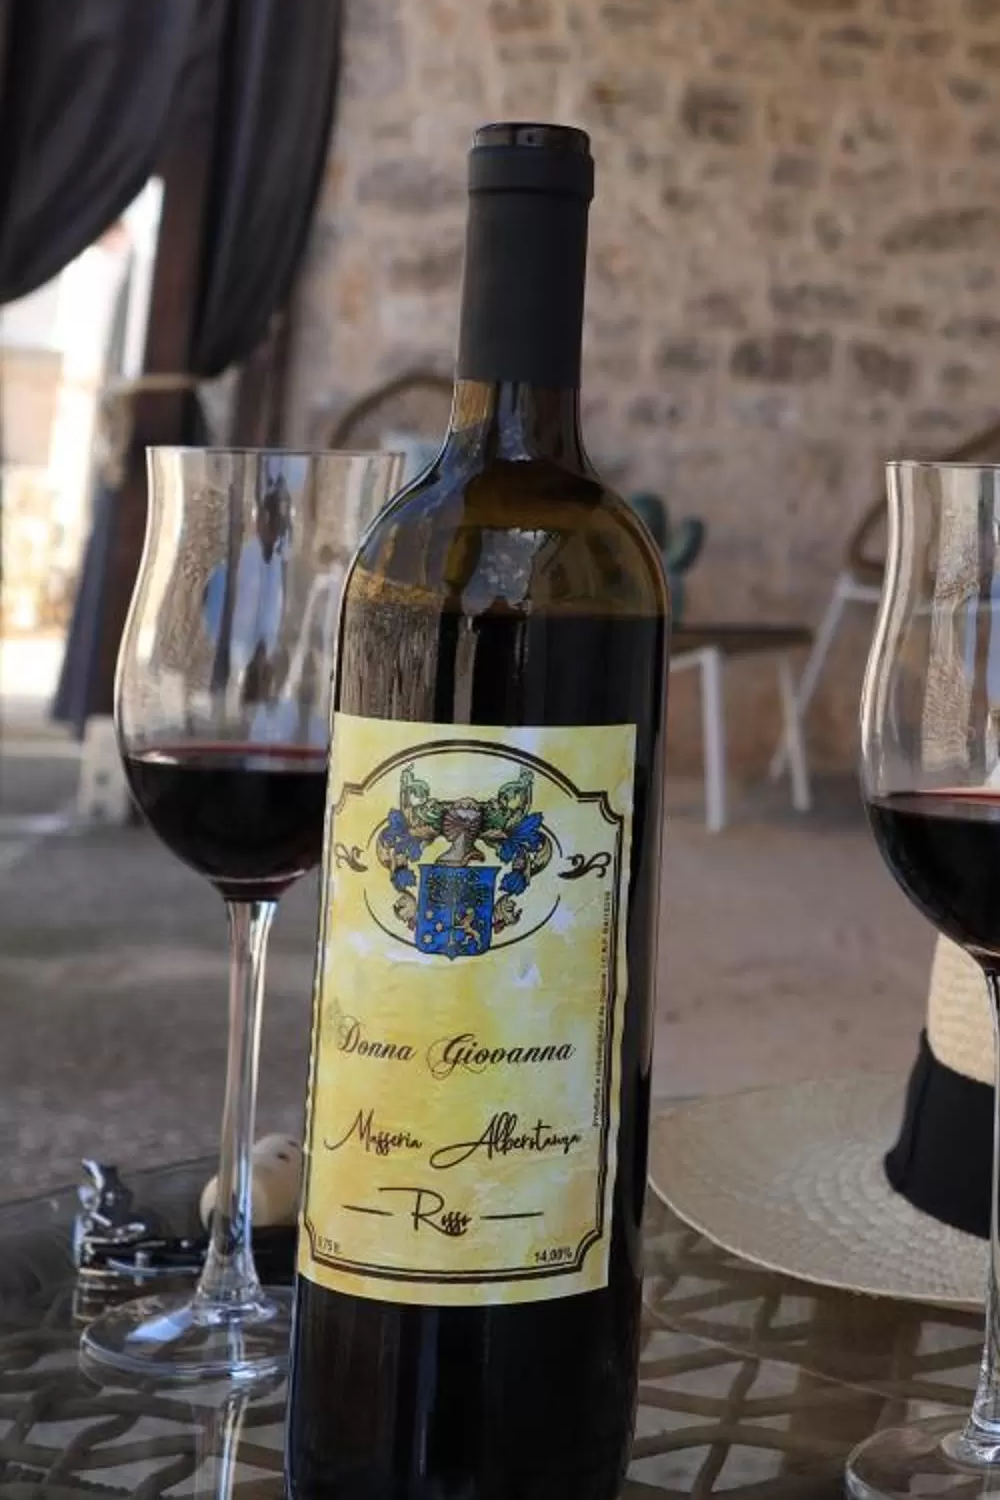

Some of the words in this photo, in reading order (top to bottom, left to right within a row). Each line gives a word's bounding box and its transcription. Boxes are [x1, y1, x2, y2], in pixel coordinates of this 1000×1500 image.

[336, 1015, 415, 1057] Donna
[427, 1032, 576, 1080] Giovanna
[323, 1108, 423, 1156] Masseria
[377, 1186, 473, 1237] Rosso
